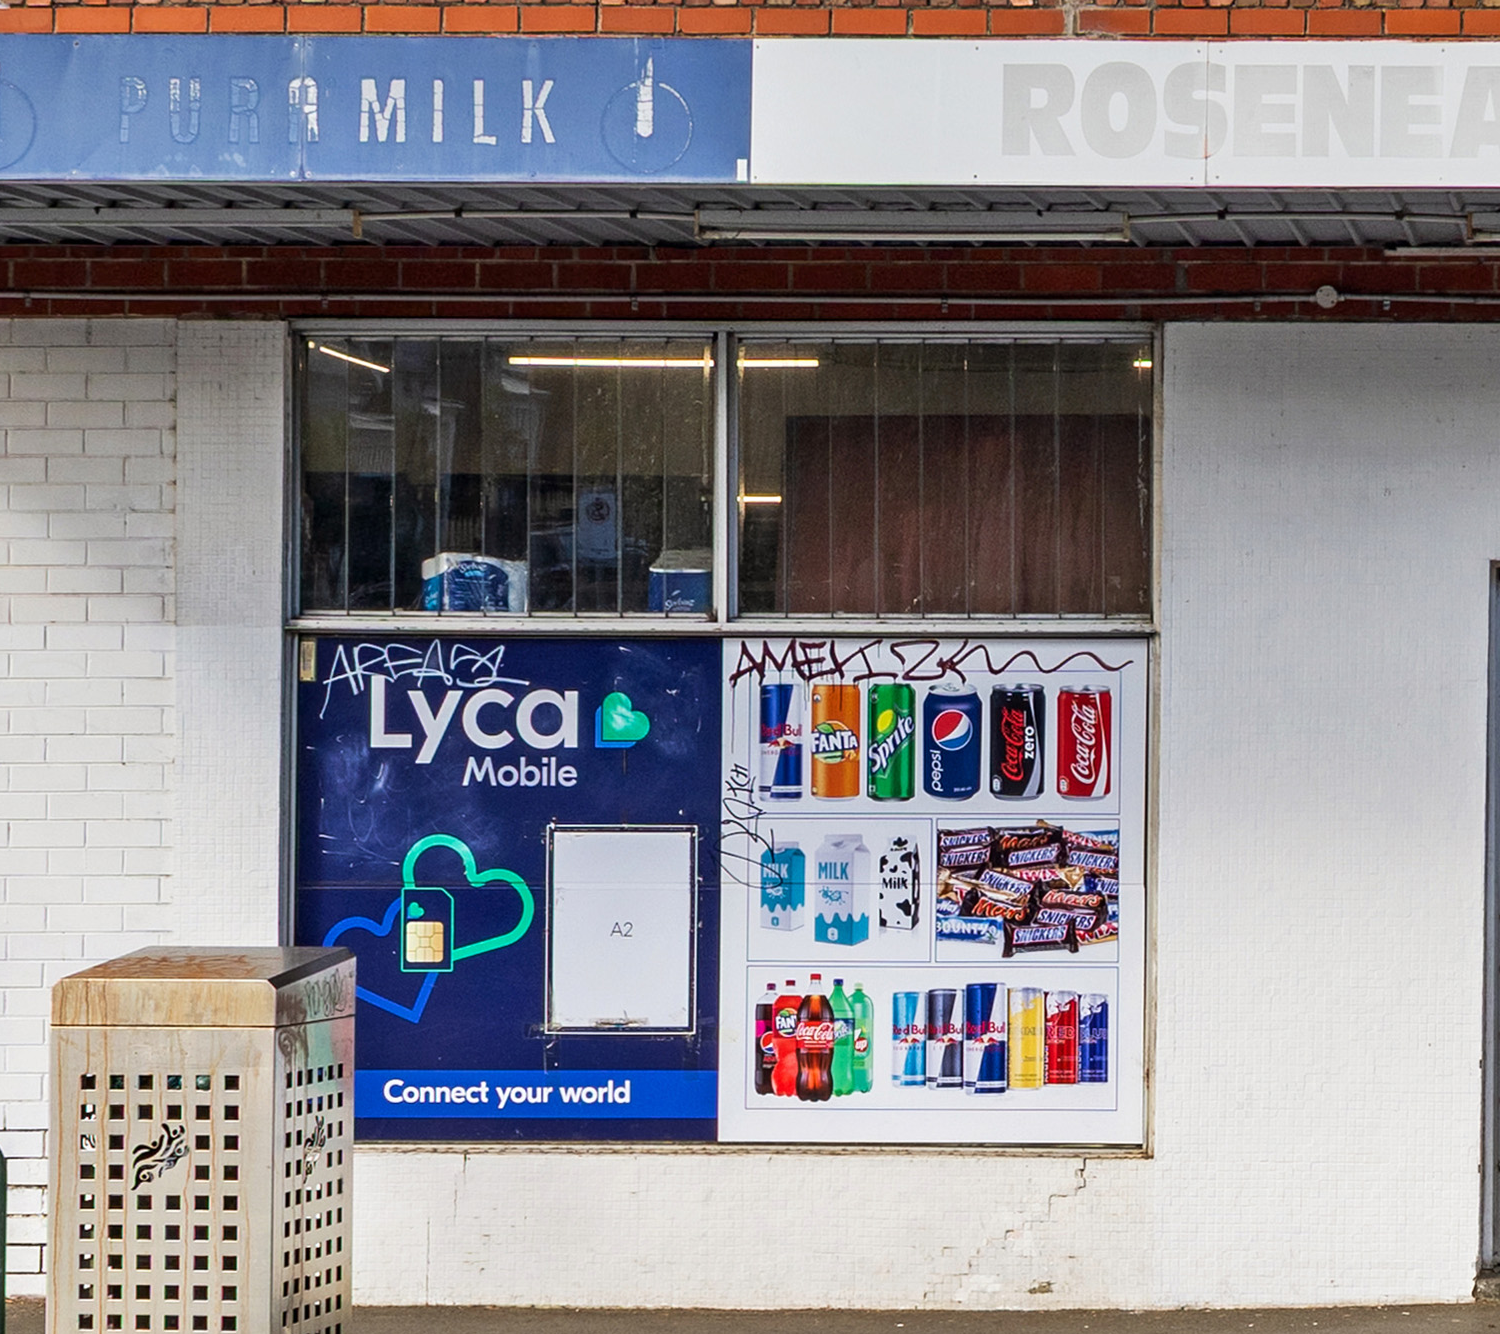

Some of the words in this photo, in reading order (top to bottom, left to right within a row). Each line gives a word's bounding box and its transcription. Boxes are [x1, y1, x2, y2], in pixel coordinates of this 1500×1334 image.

[118, 76, 319, 144] PURA
[359, 78, 556, 145] MILK
[370, 675, 579, 763] Lyca
[868, 715, 915, 773] Sprite
[1024, 726, 1035, 759] zero
[462, 757, 578, 787] Mobile
[930, 749, 944, 792] pepsi
[941, 849, 988, 866] SNICKERS
[1009, 848, 1055, 866] SNICKERS
[763, 863, 789, 878] MILK
[818, 862, 849, 880] MILK
[881, 877, 908, 890] Milk
[972, 897, 1030, 921] Mars
[609, 922, 633, 938] A2
[1014, 925, 1067, 944] SNICKERS
[383, 1079, 488, 1105] Connect
[496, 1085, 557, 1110] your
[559, 1079, 631, 1105] world
